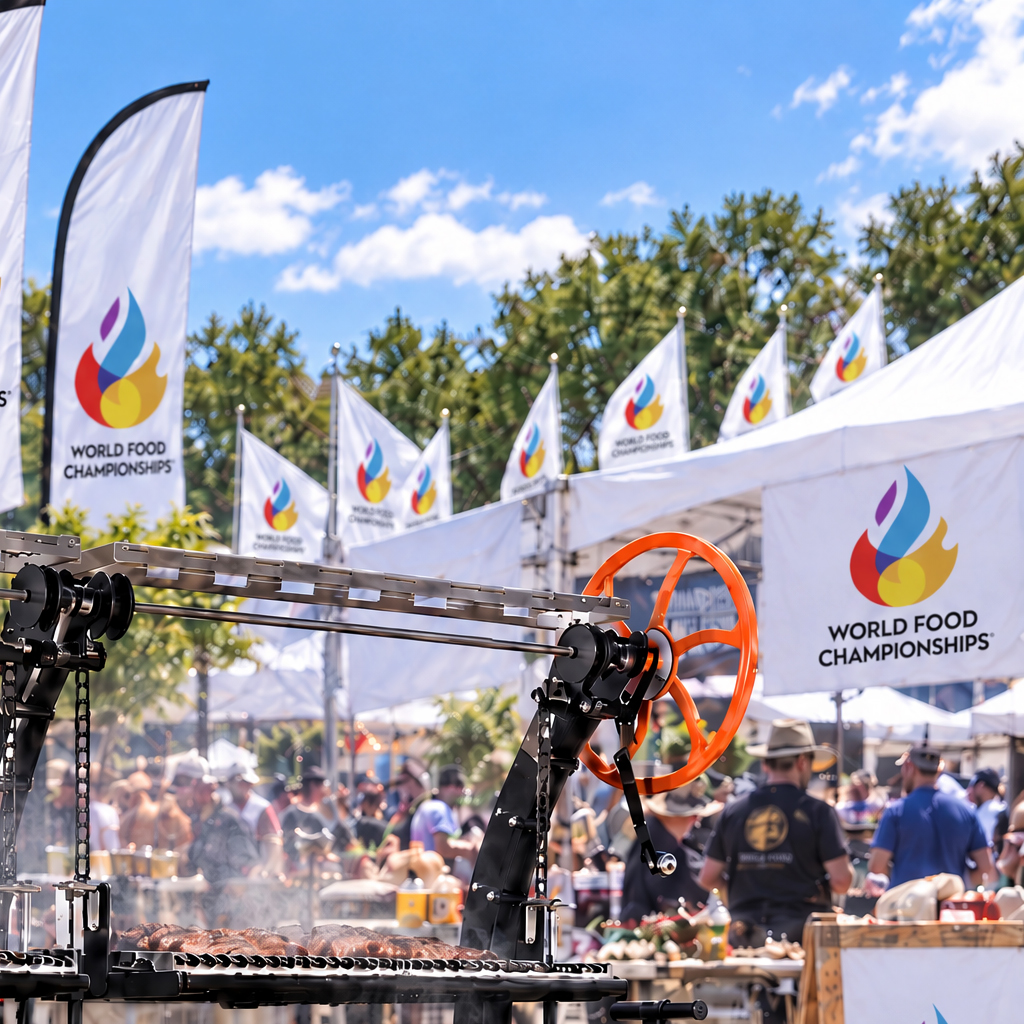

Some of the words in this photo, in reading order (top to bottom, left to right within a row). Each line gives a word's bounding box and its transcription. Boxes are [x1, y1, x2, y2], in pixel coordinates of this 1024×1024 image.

[70, 442, 125, 459] WORLD
[127, 441, 167, 457] FOOD
[828, 617, 908, 642] WORLD
[914, 609, 979, 634] FOOD
